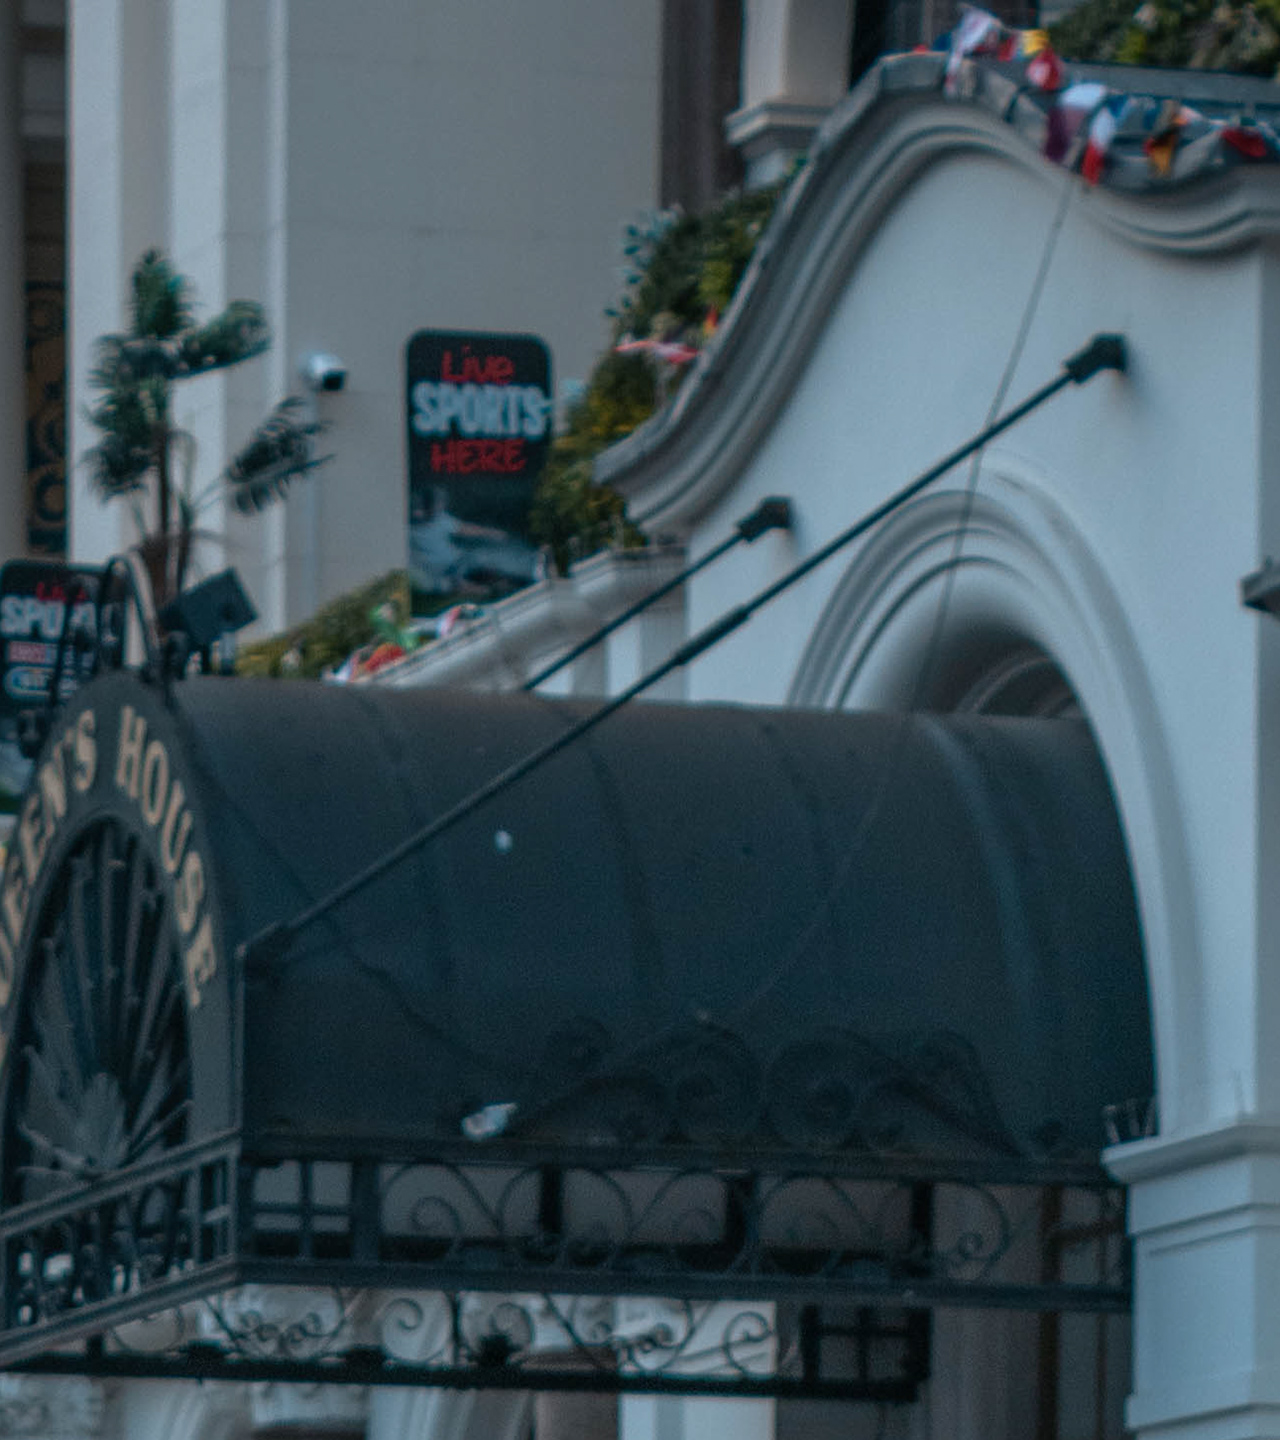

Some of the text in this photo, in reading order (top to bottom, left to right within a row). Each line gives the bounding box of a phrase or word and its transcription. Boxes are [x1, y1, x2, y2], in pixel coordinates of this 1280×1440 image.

[441, 345, 516, 386] Live
[412, 380, 550, 436] SPORTS
[430, 437, 527, 475] HERE
[115, 703, 219, 1009] HOUSE
